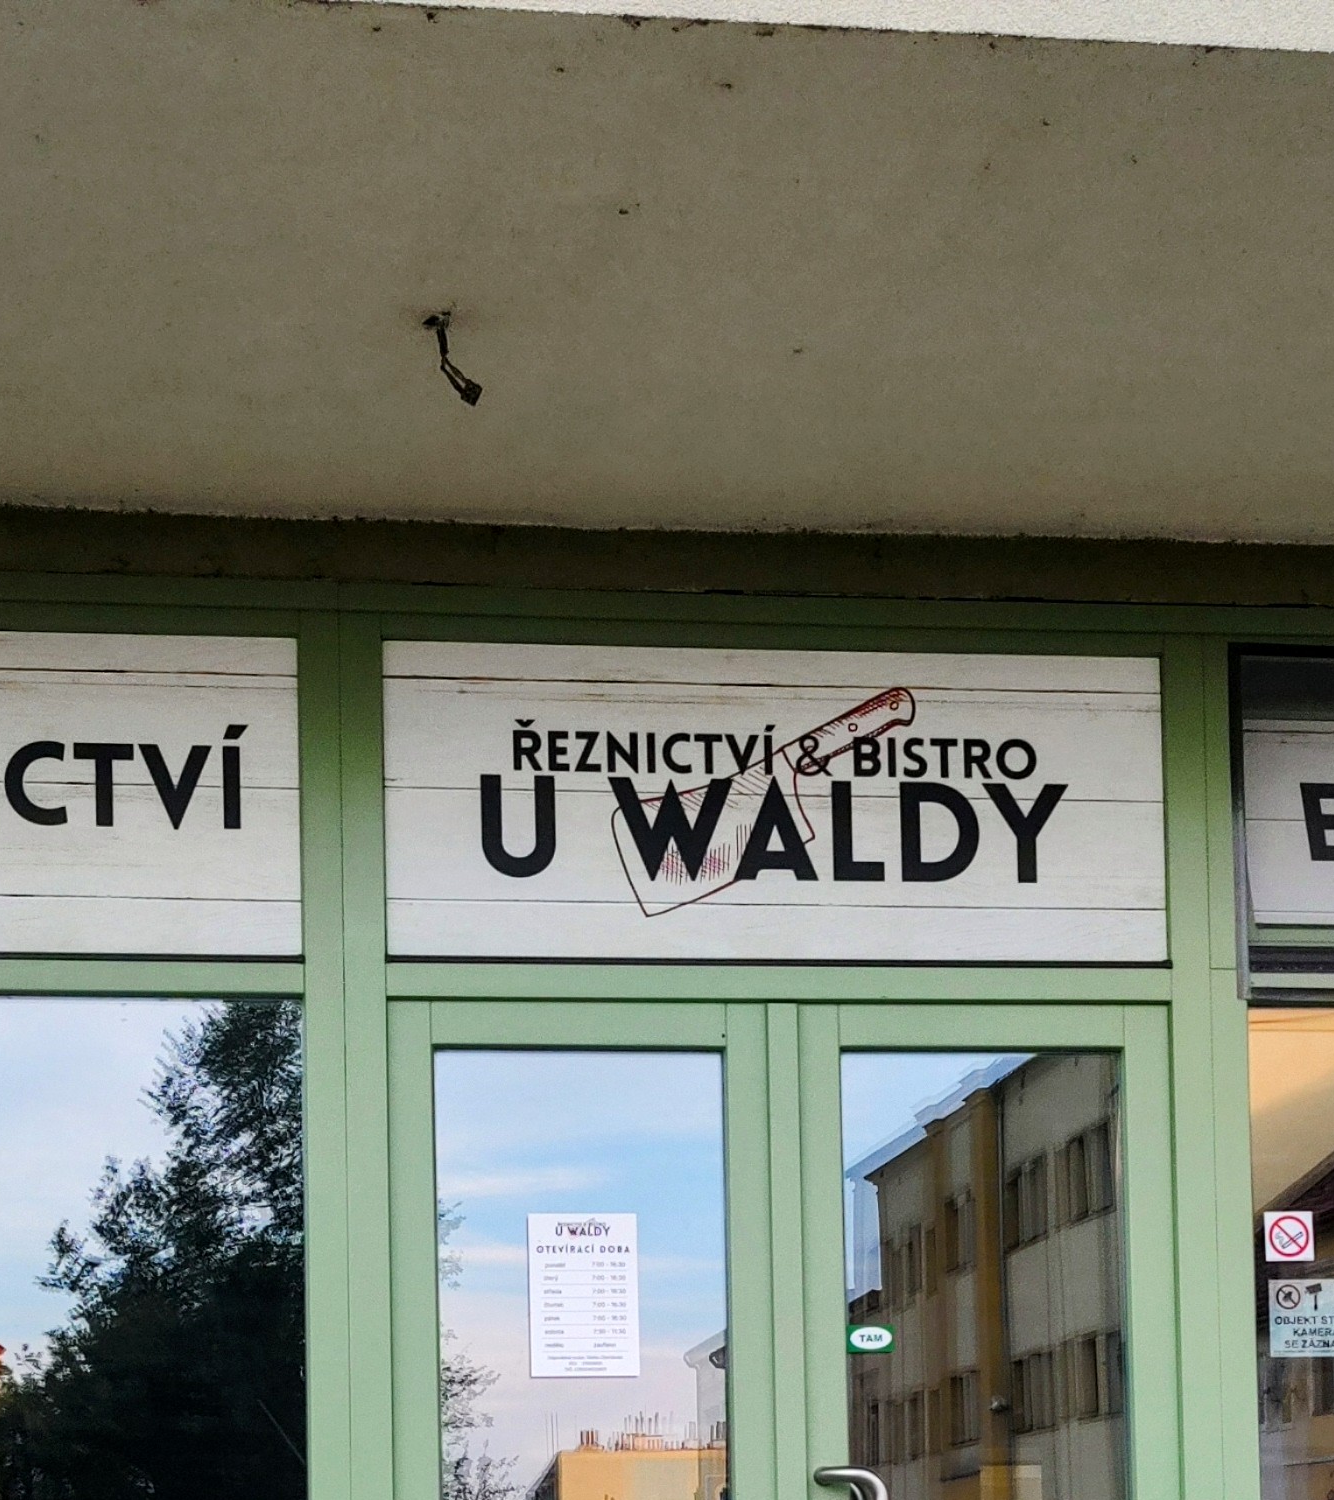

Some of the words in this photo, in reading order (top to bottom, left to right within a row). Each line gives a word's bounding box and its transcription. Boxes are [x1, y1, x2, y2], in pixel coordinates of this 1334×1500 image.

[512, 719, 776, 776] ŘEZNICTVÍ
[795, 733, 833, 778] &
[854, 736, 1037, 781] BISTRO
[480, 774, 556, 878] U
[610, 776, 1069, 884] WALDY
[555, 1225, 563, 1237] U
[567, 1225, 611, 1237] WALDY
[536, 1243, 594, 1254] OTEVÍRACÍ
[599, 1245, 630, 1254] DOBA
[1274, 1315, 1317, 1325] OBJEKT
[859, 1334, 883, 1343] TAM
[1284, 1340, 1299, 1348] SE
